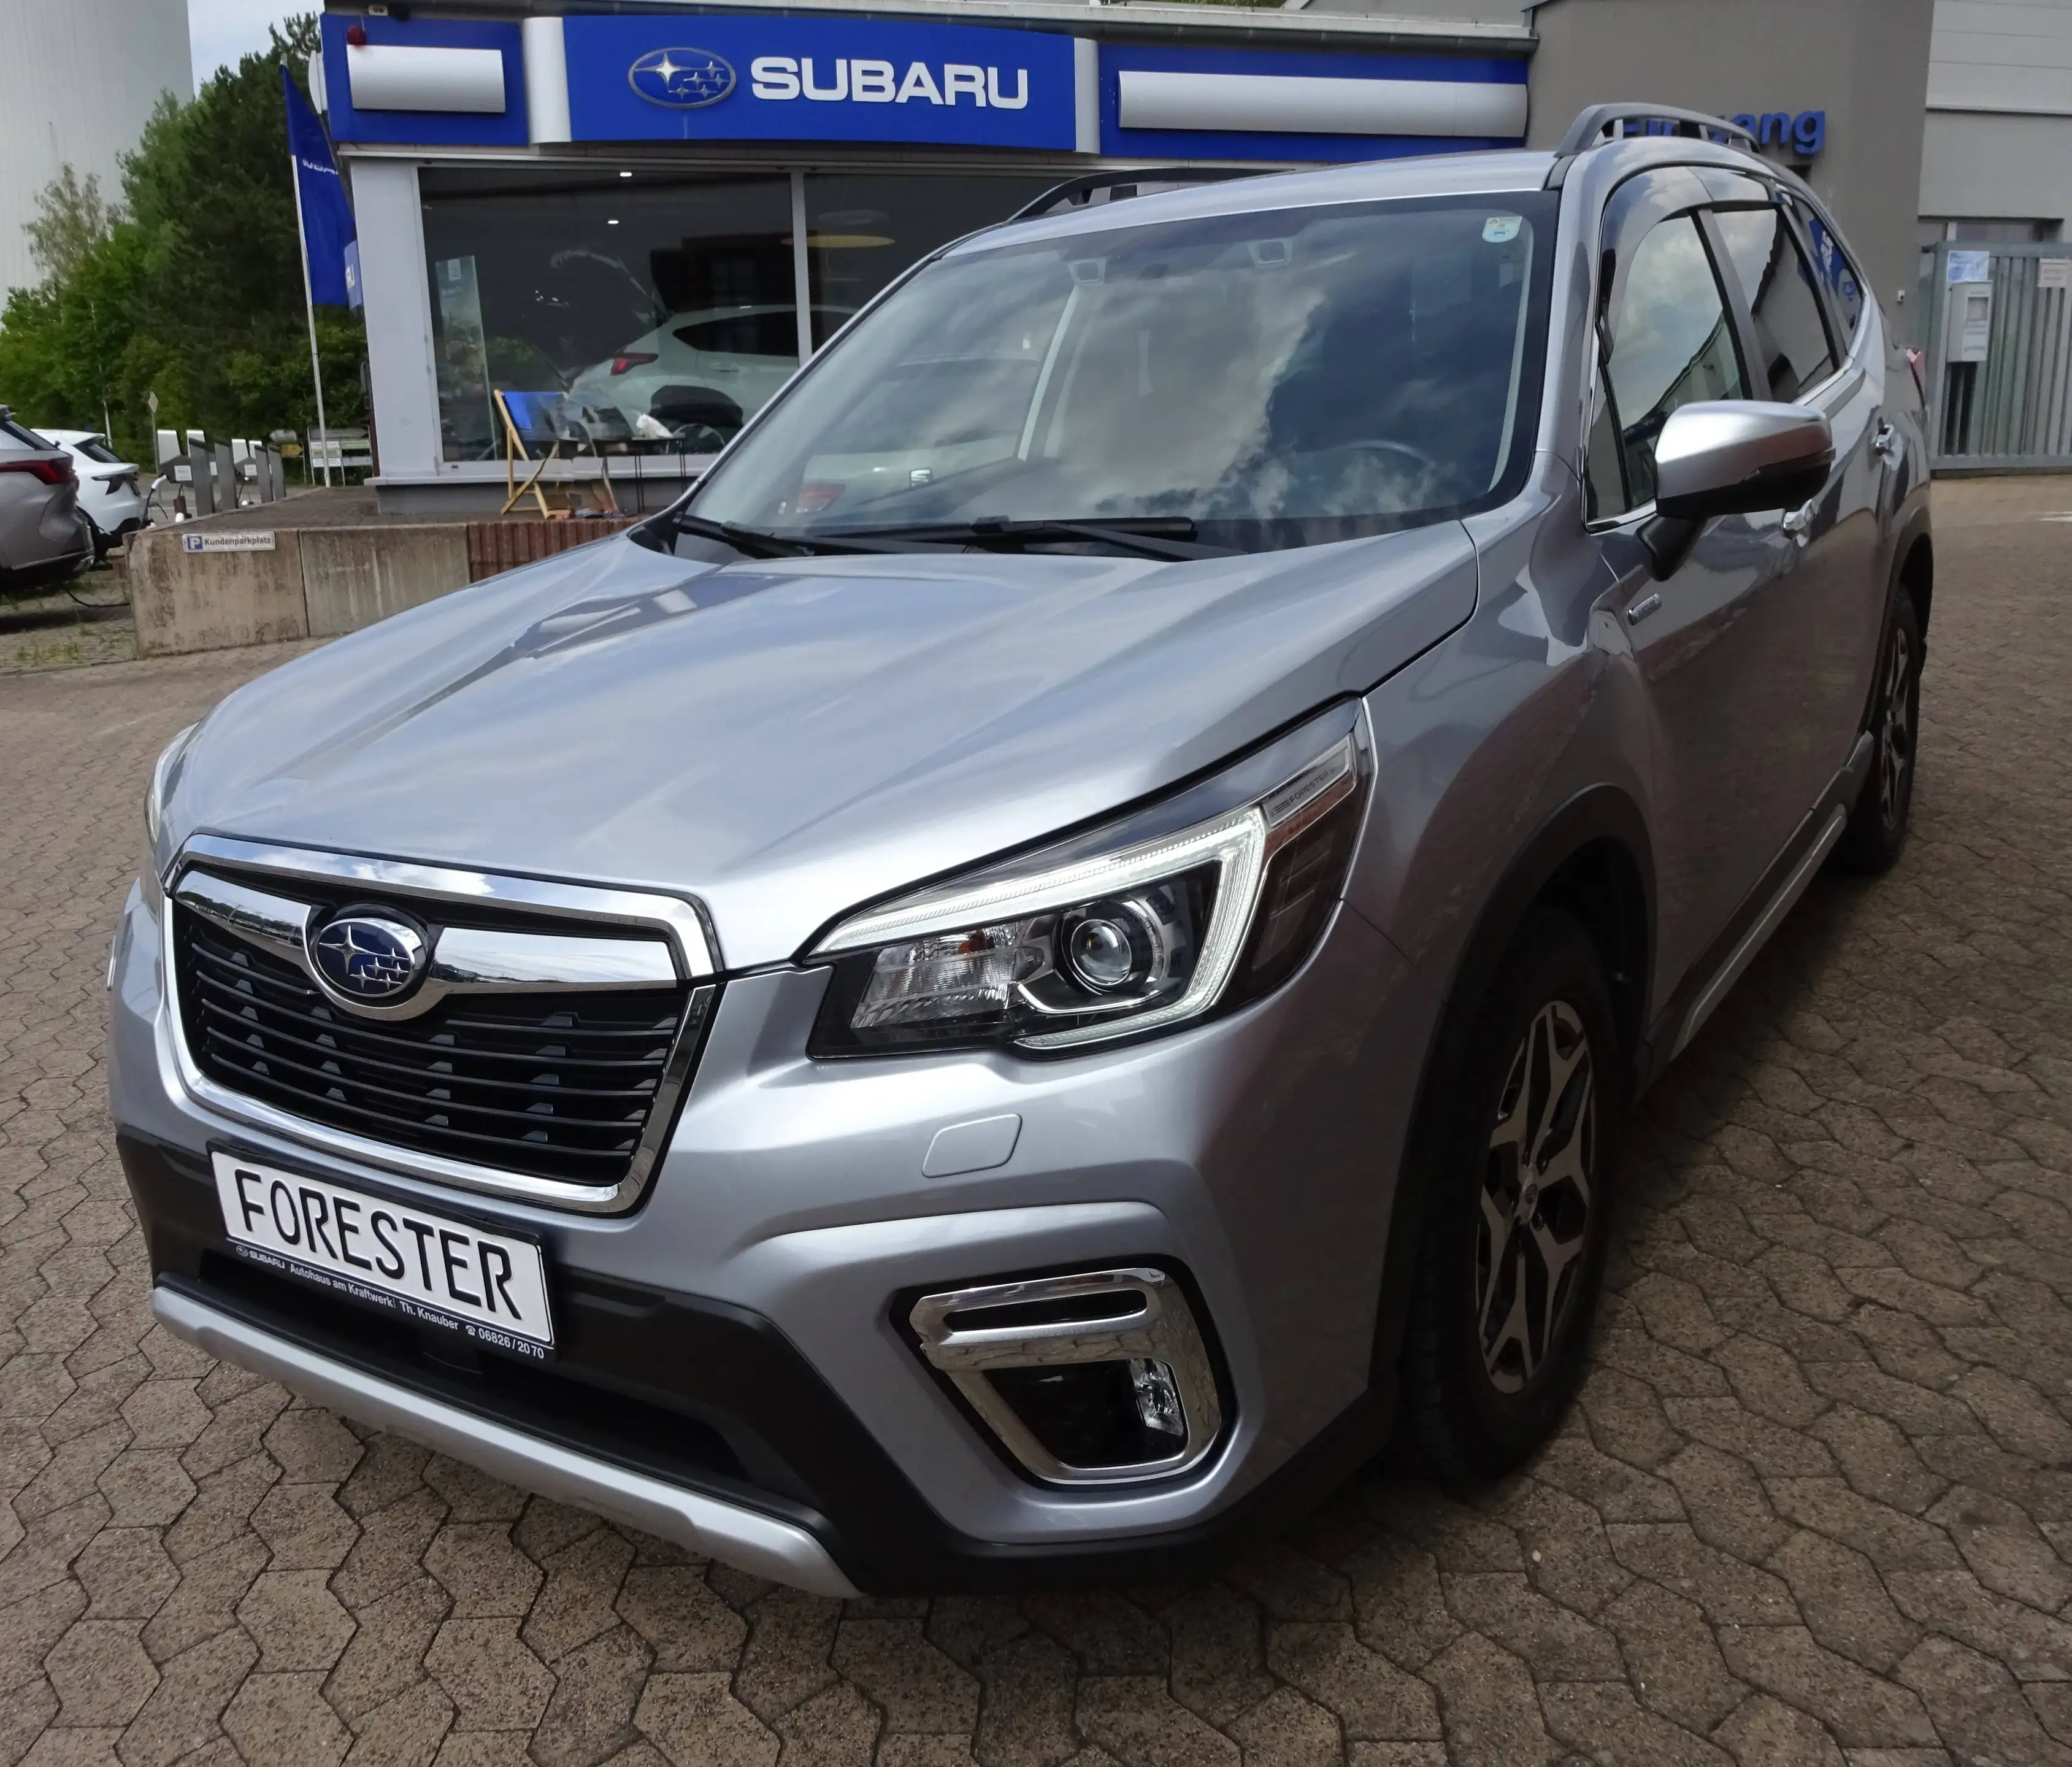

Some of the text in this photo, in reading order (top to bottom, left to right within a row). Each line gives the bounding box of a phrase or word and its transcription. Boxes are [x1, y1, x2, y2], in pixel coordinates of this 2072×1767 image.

[751, 56, 1028, 109] SUBARU
[204, 537, 272, 547] Kundenparkplatz
[1290, 770, 1330, 803] FORESTER
[234, 1169, 523, 1320] FORESTER
[249, 1250, 285, 1269] SUBARU
[290, 1263, 331, 1286] Autohaus
[332, 1279, 347, 1292] am
[347, 1283, 394, 1309] Kraftwerk
[399, 1300, 416, 1316] Th.
[418, 1306, 459, 1331] Knauber
